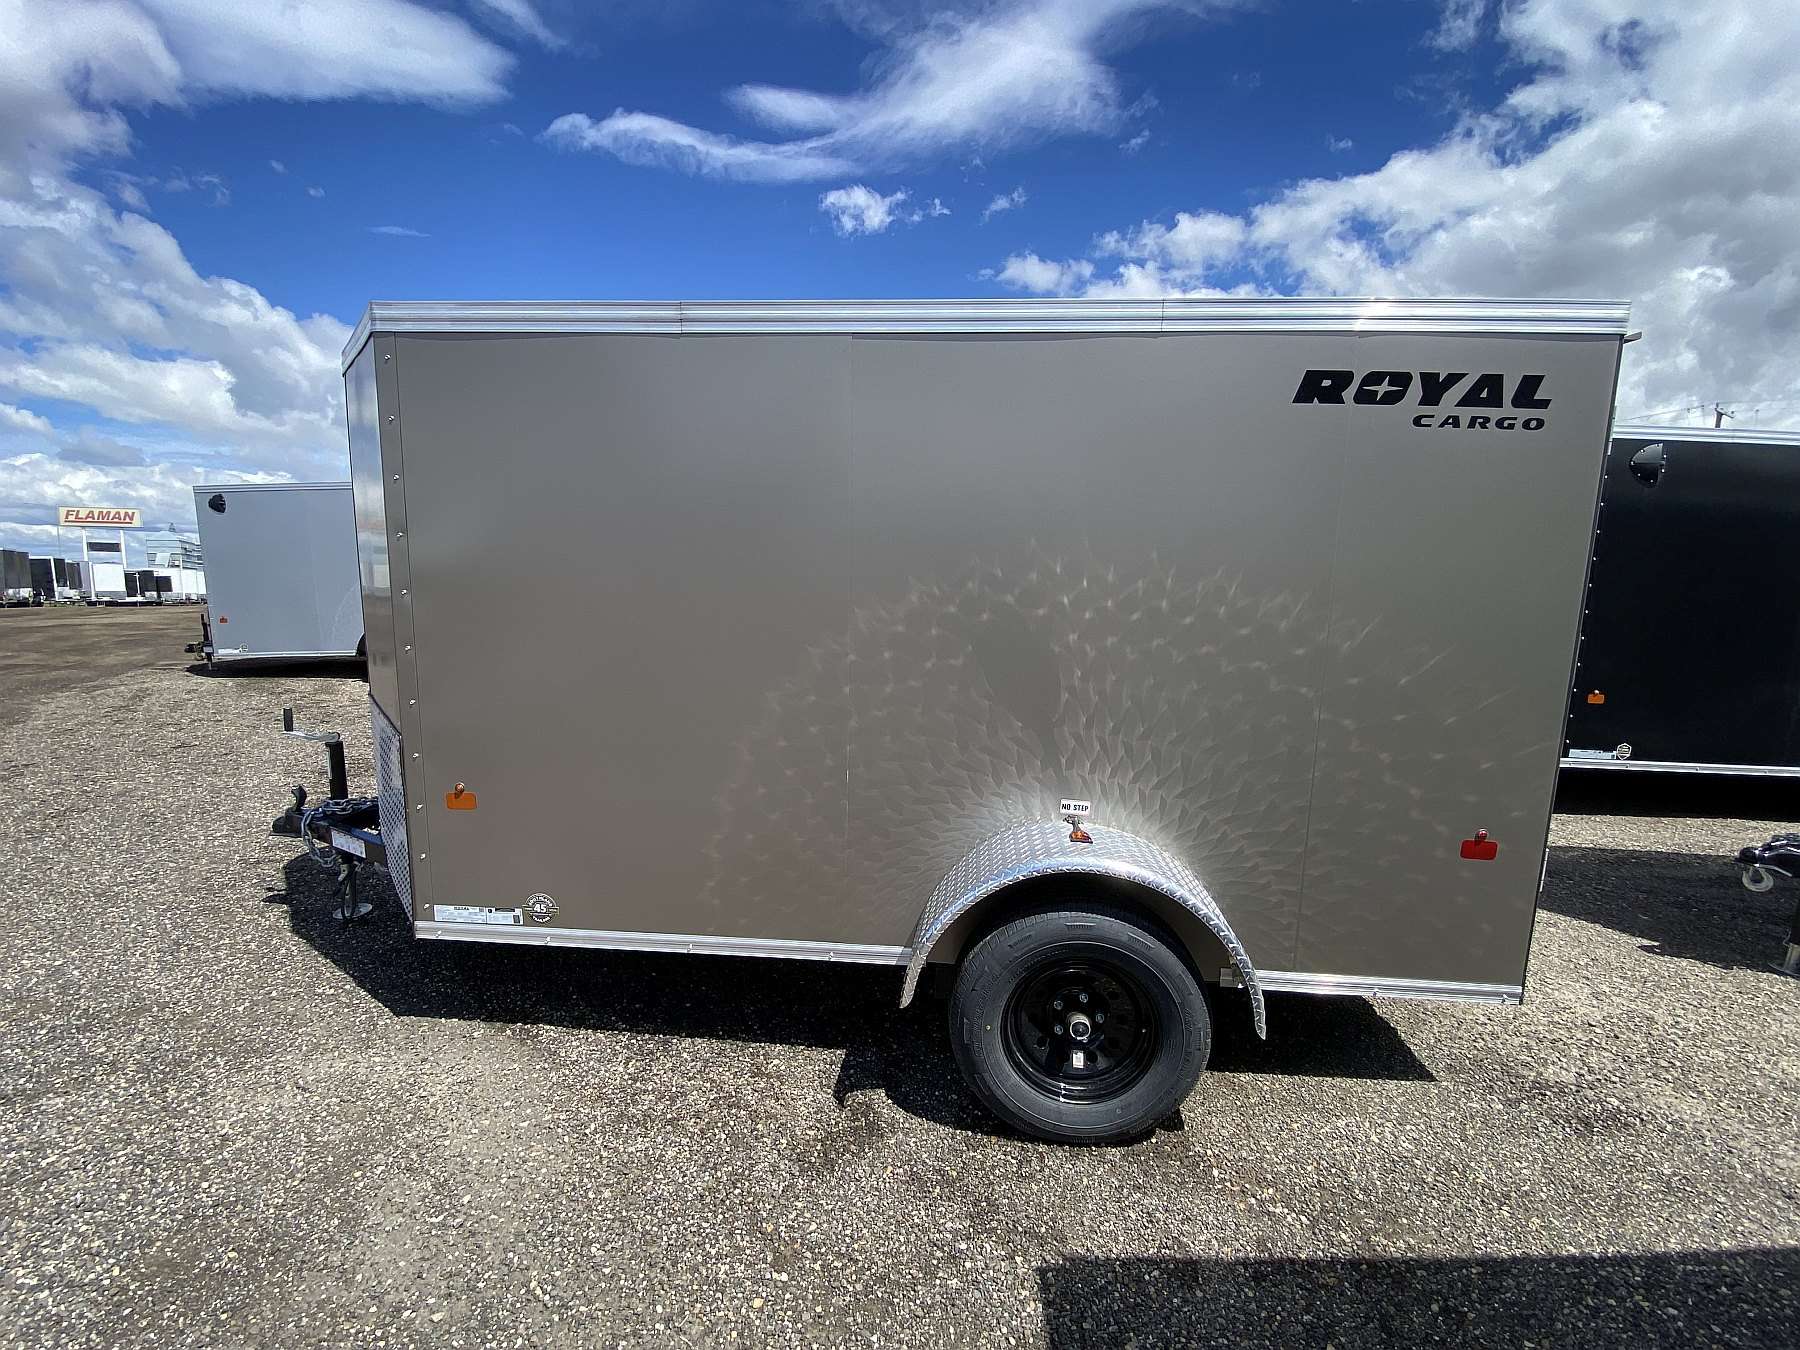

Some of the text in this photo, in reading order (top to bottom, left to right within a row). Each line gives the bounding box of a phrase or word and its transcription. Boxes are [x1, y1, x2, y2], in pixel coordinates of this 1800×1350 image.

[1292, 369, 1553, 409] ROYAL
[1412, 414, 1546, 431] CARGO
[64, 509, 135, 522] FLAMAN
[1061, 803, 1089, 812] NO STEP
[534, 904, 546, 912] 45
